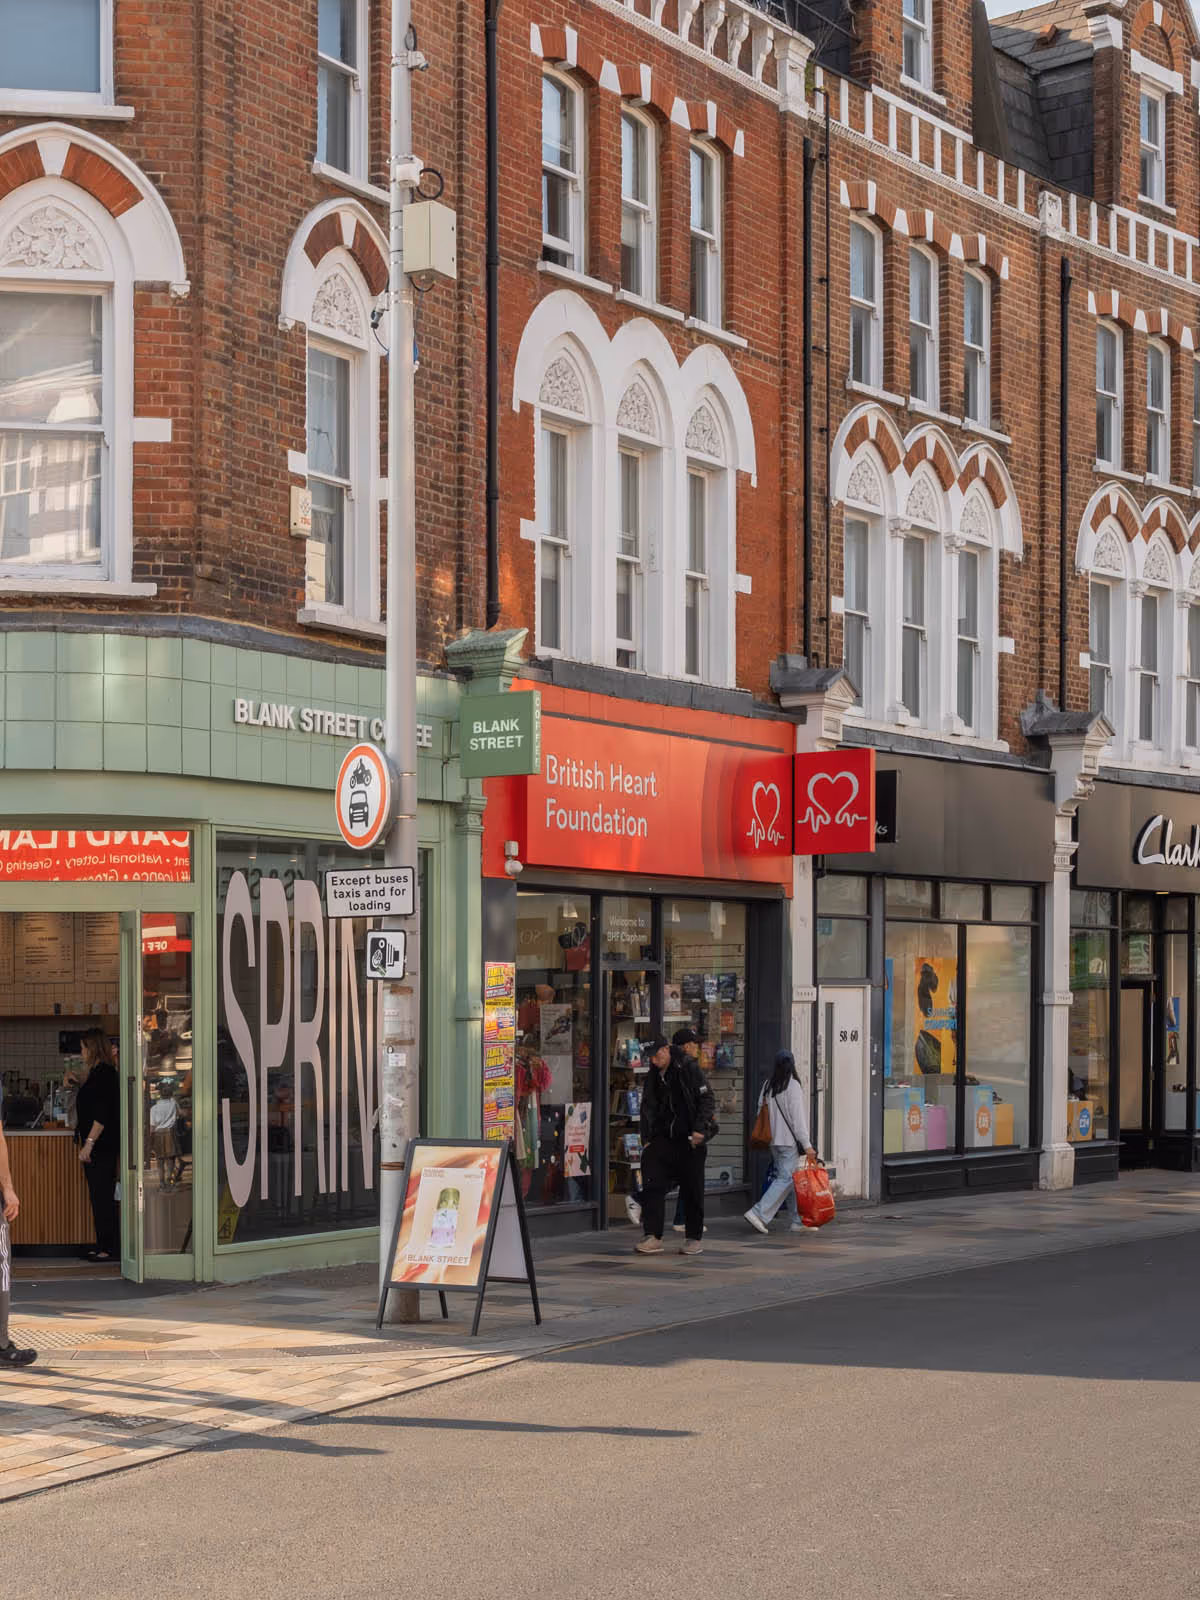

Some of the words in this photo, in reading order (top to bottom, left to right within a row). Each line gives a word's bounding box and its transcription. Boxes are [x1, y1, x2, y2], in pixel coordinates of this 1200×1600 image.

[234, 698, 296, 730] BLANK
[300, 707, 367, 739] STREET
[370, 718, 433, 748] CEE
[473, 718, 520, 734] BLANK
[470, 735, 524, 751] STREET
[546, 754, 604, 791] British
[610, 763, 658, 797] Heart
[546, 798, 648, 837] Foundation
[331, 875, 371, 887] Except
[375, 874, 408, 884] buses
[333, 889, 360, 899] taxis
[365, 887, 385, 897] and
[390, 886, 406, 896] for
[349, 901, 391, 912] loading
[223, 870, 383, 1208] SPRIN
[839, 1030, 848, 1042] 58
[850, 1030, 859, 1042] 60
[407, 1254, 435, 1263] BLANK
[436, 1255, 470, 1265] STREET
